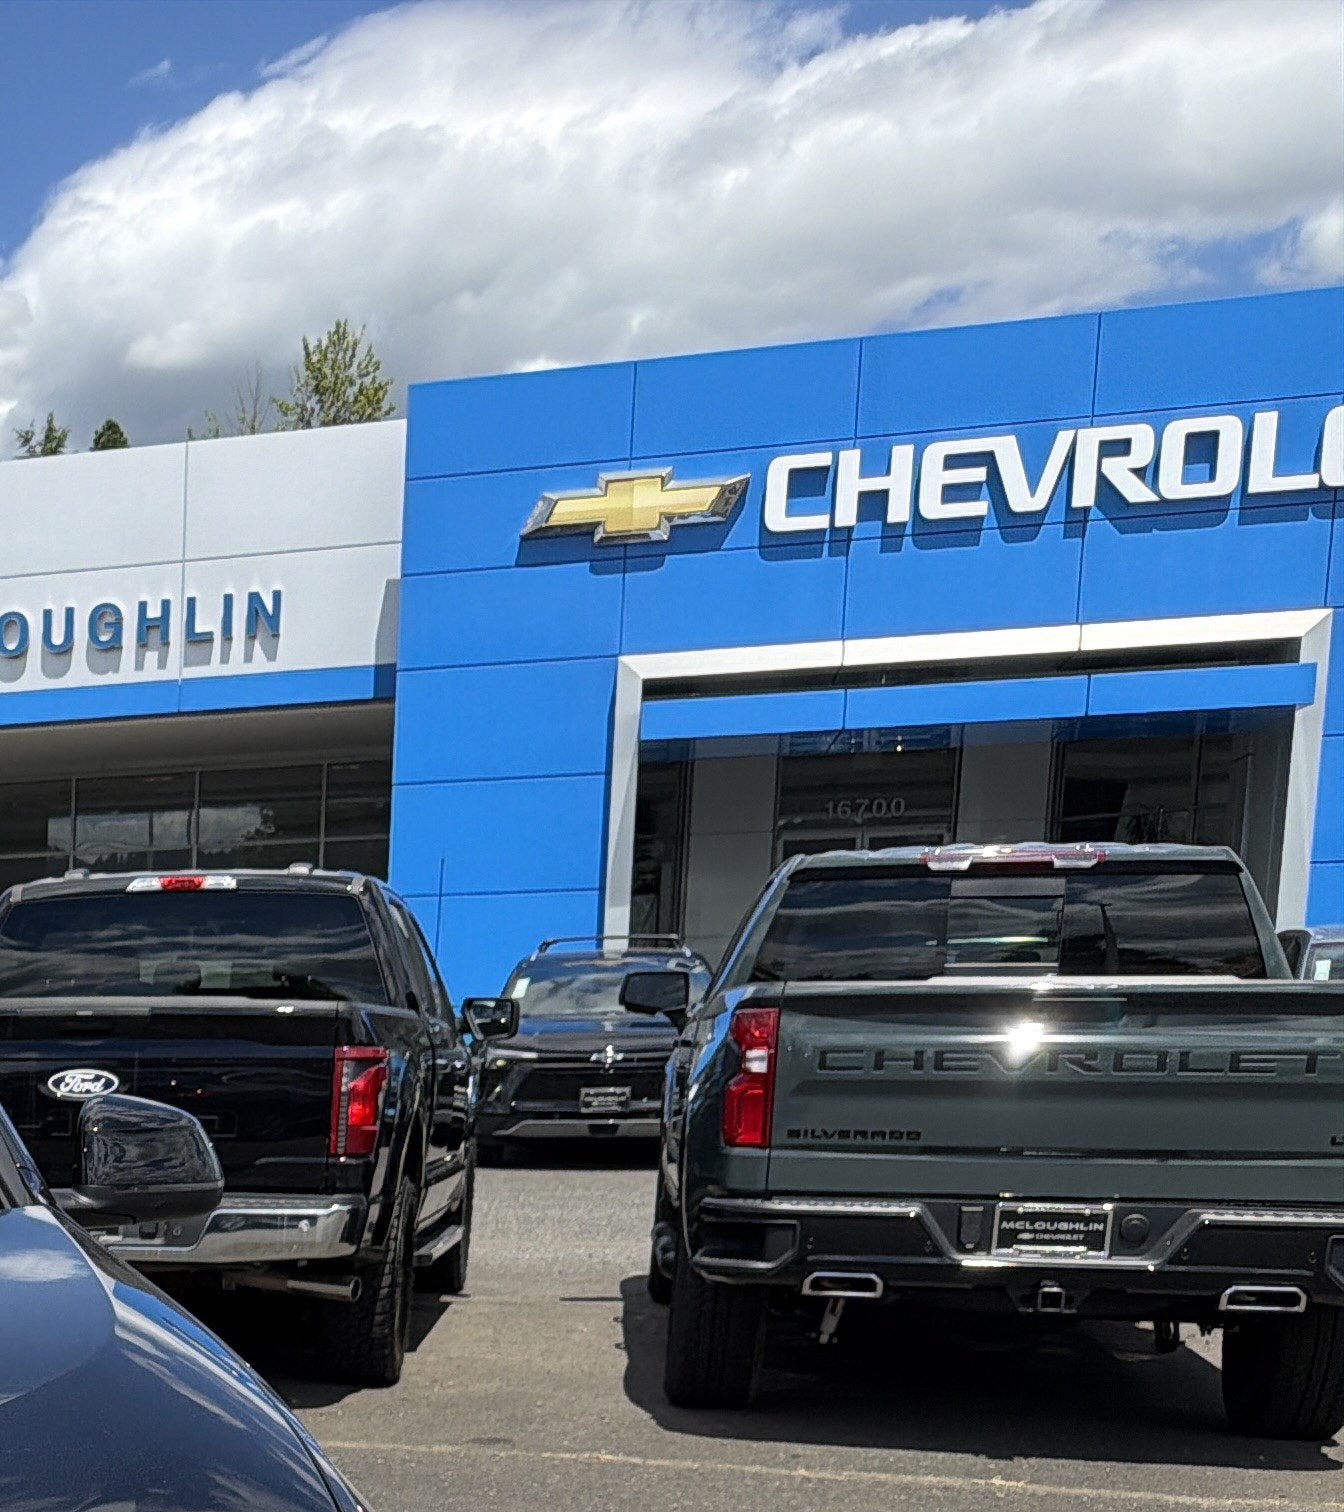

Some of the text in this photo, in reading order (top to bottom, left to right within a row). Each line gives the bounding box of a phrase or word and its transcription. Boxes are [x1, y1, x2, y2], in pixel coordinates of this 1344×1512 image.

[825, 797, 906, 824] 16700
[816, 1050, 1341, 1077] CHEVROLET
[59, 1073, 106, 1094] Ford
[786, 1128, 922, 1141] SILVERADO
[1000, 1220, 1105, 1232] MCLOUGHLIN
